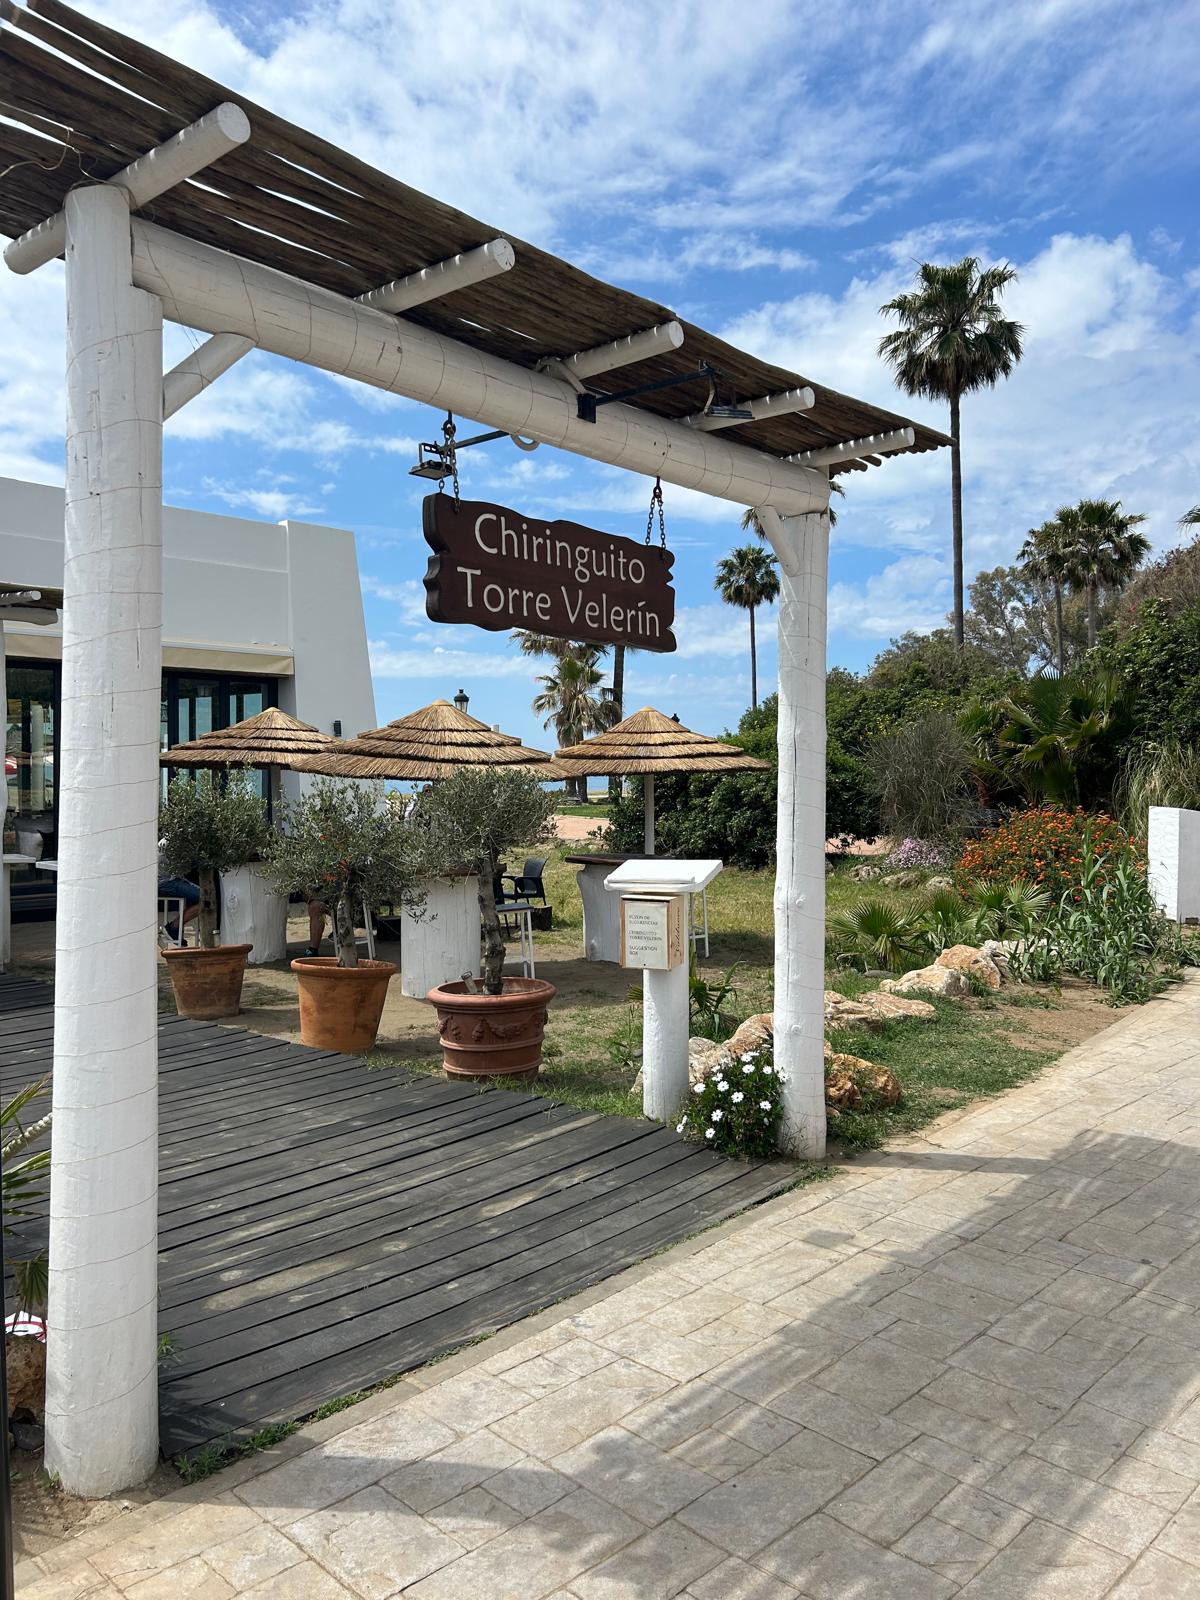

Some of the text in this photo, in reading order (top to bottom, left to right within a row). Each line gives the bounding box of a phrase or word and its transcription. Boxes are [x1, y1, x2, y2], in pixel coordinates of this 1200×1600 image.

[474, 513, 646, 584] Chiringuito
[456, 566, 660, 637] Torre Velerín
